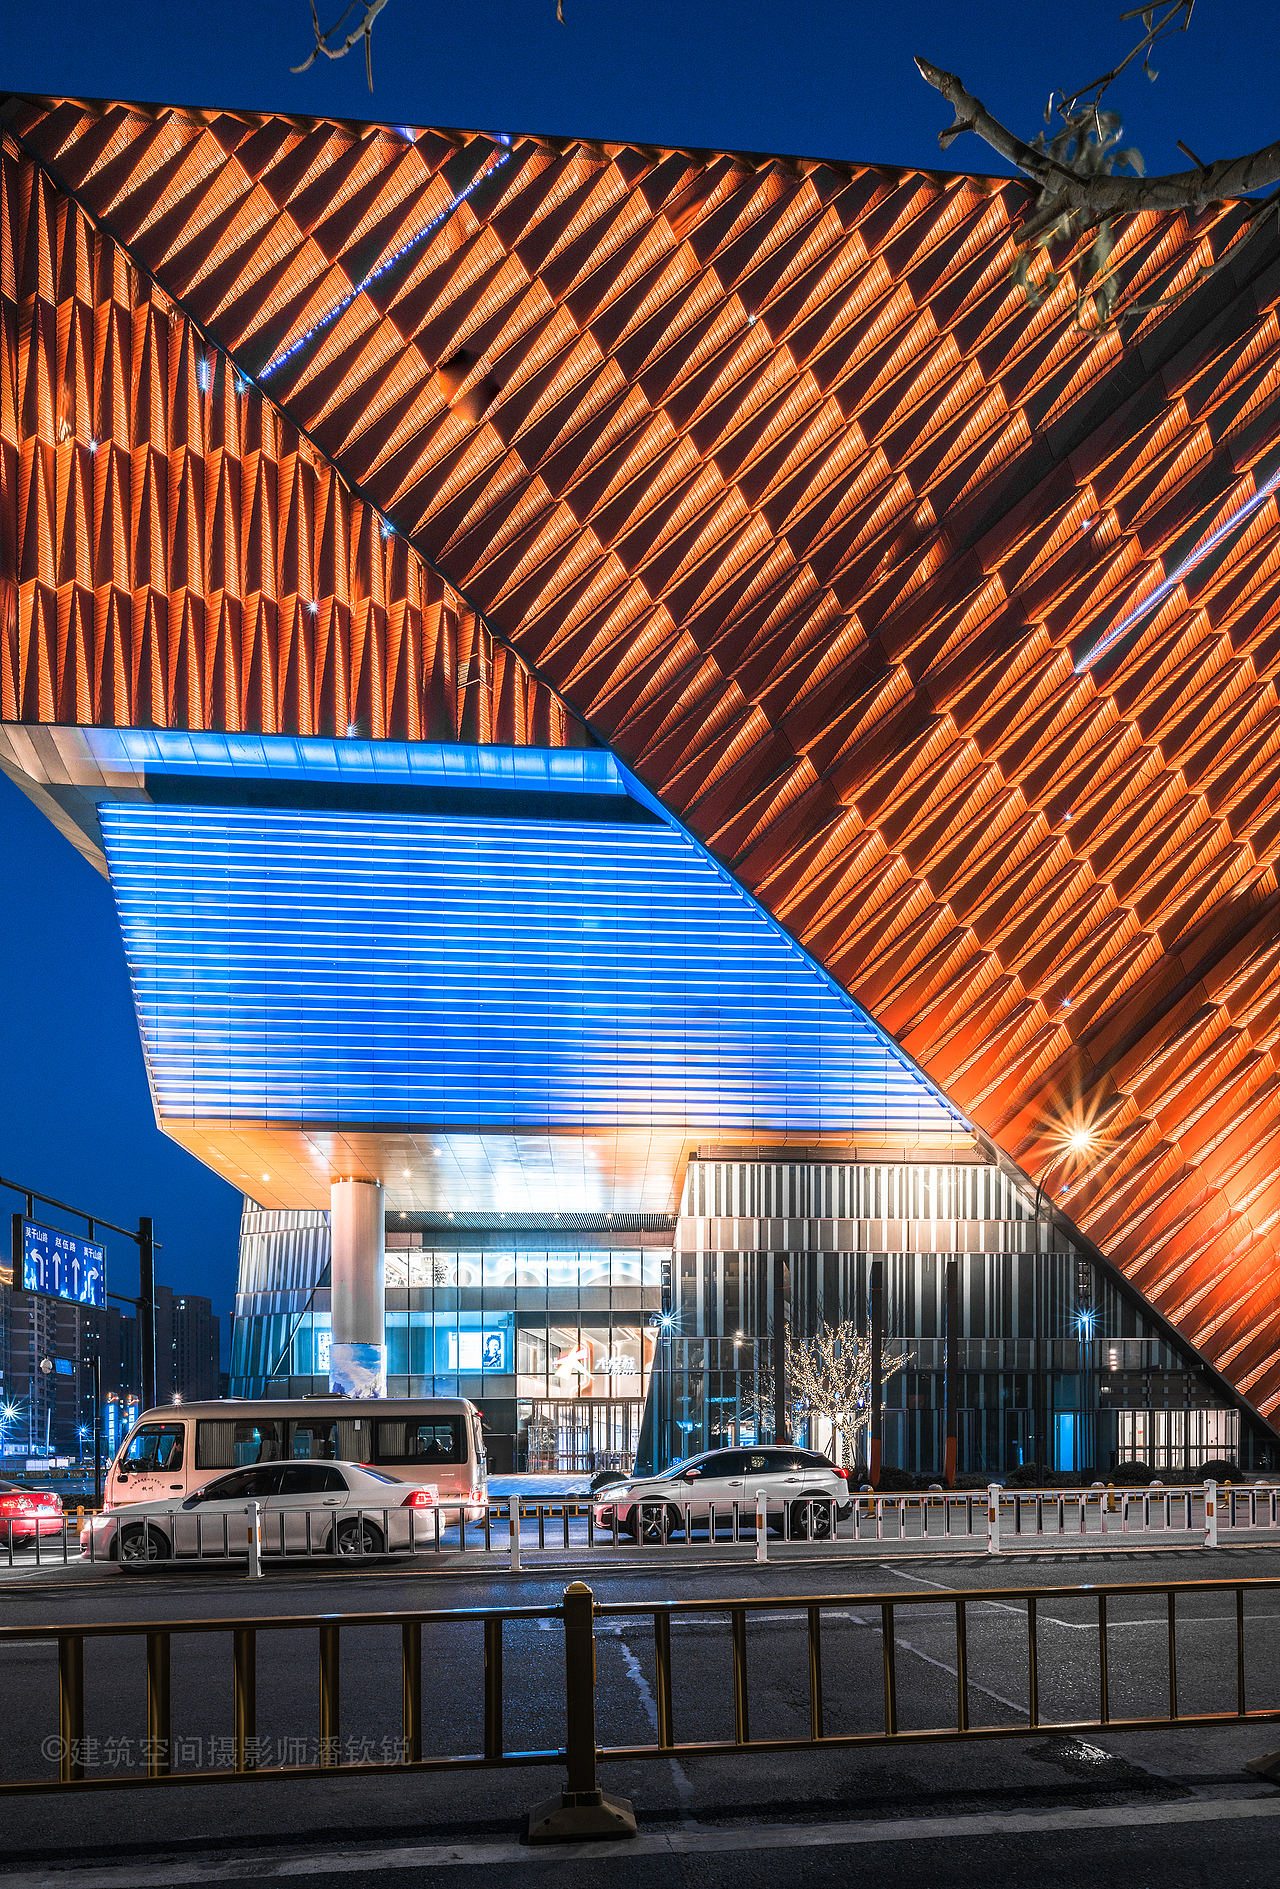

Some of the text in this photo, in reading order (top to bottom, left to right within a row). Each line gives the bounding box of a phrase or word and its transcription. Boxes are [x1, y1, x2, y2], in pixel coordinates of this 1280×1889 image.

[25, 1226, 48, 1243] 莫干山路
[83, 1246, 103, 1262] 莫干山路
